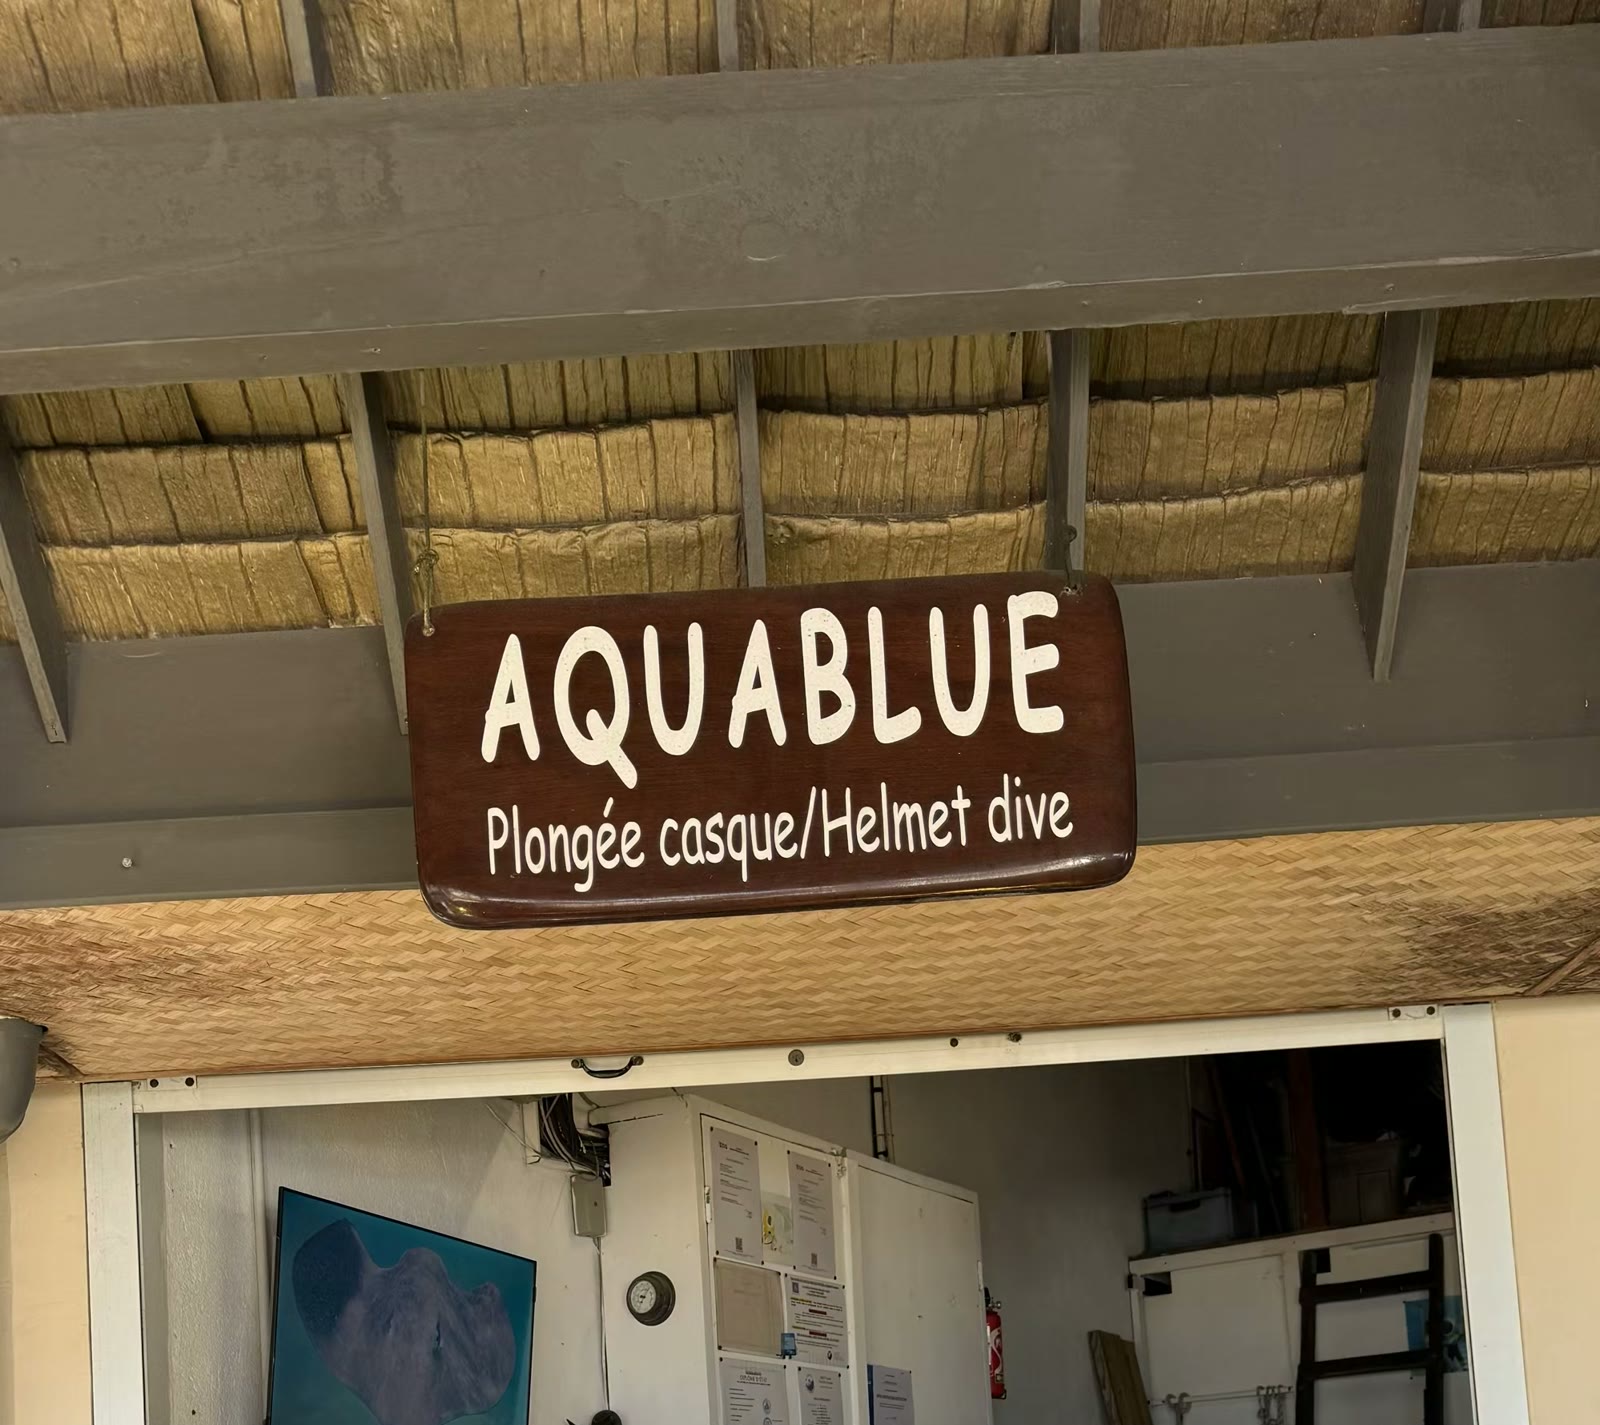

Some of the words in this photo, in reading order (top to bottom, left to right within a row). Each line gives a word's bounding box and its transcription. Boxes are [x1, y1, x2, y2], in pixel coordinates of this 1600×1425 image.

[481, 591, 1064, 789] AQUABLUE
[487, 797, 645, 893] Plongée
[659, 781, 971, 883] casque/Helmet
[988, 773, 1074, 843] dive
